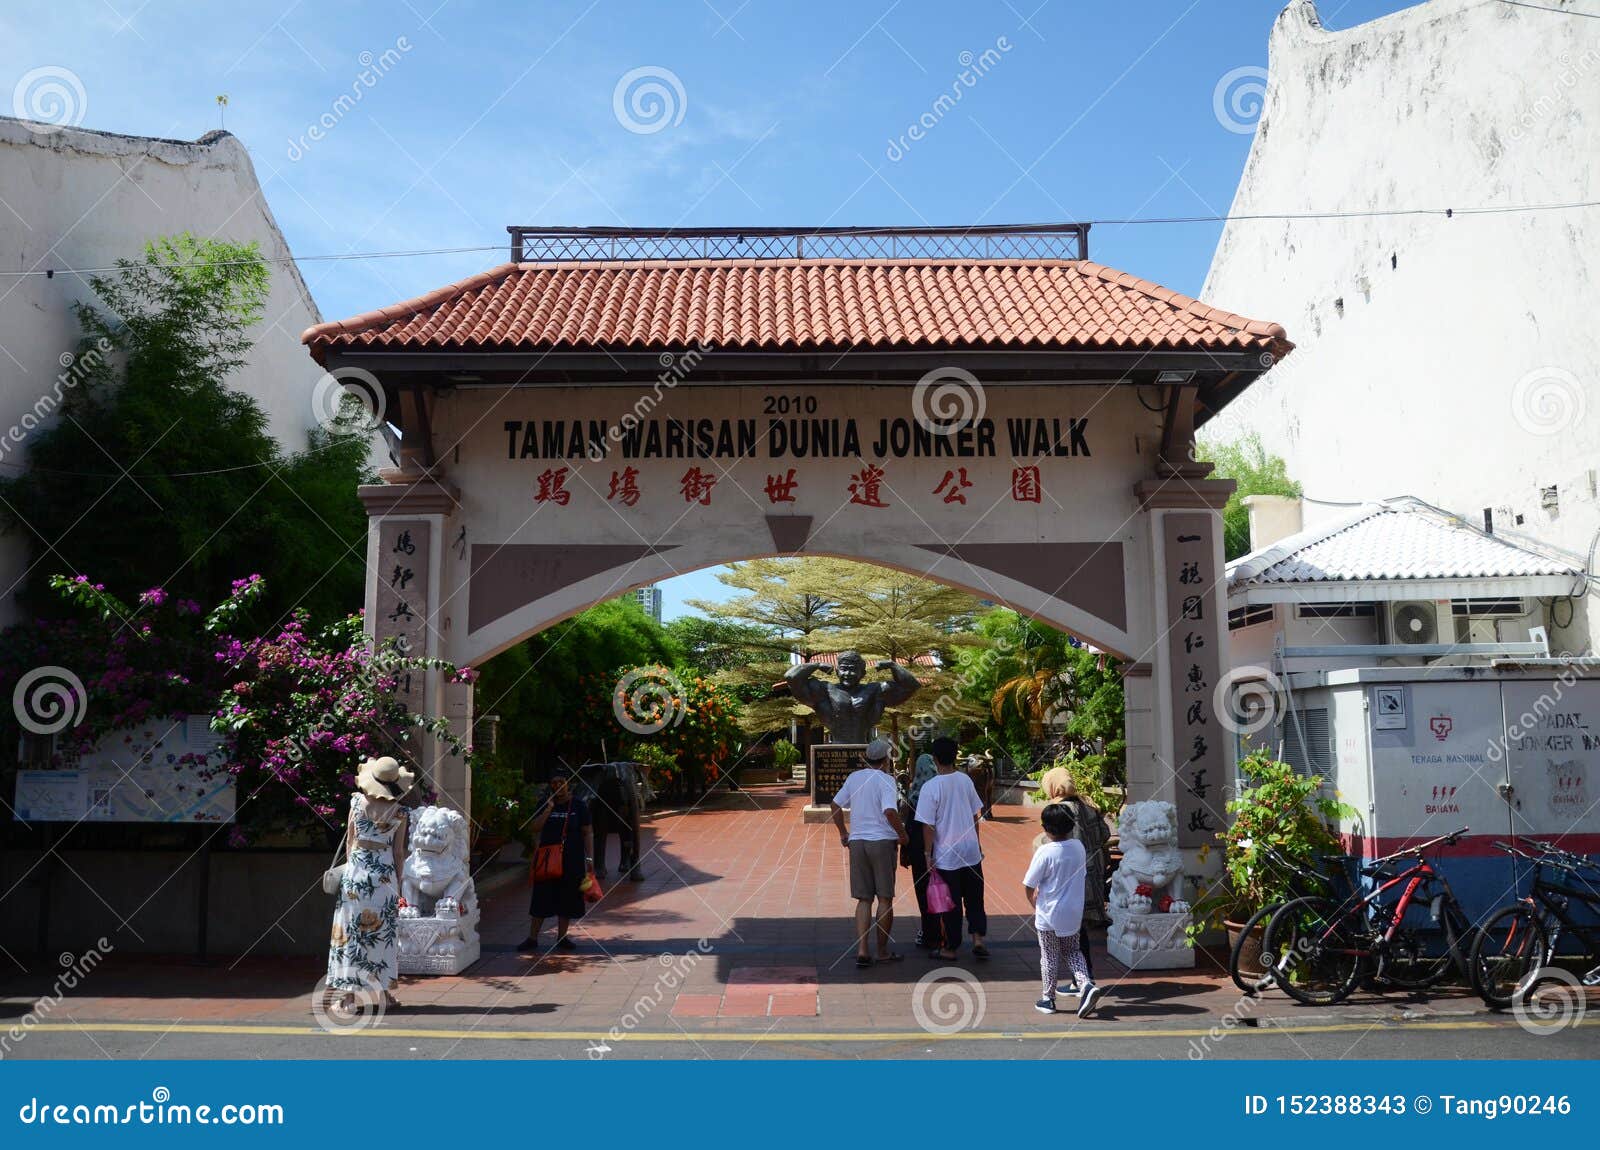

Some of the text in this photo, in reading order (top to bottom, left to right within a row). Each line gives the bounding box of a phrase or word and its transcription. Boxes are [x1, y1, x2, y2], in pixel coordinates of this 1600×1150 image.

[764, 396, 817, 414] 2010
[504, 417, 1091, 459] TAMAN WARISAN DUNIA JONKER WALK
